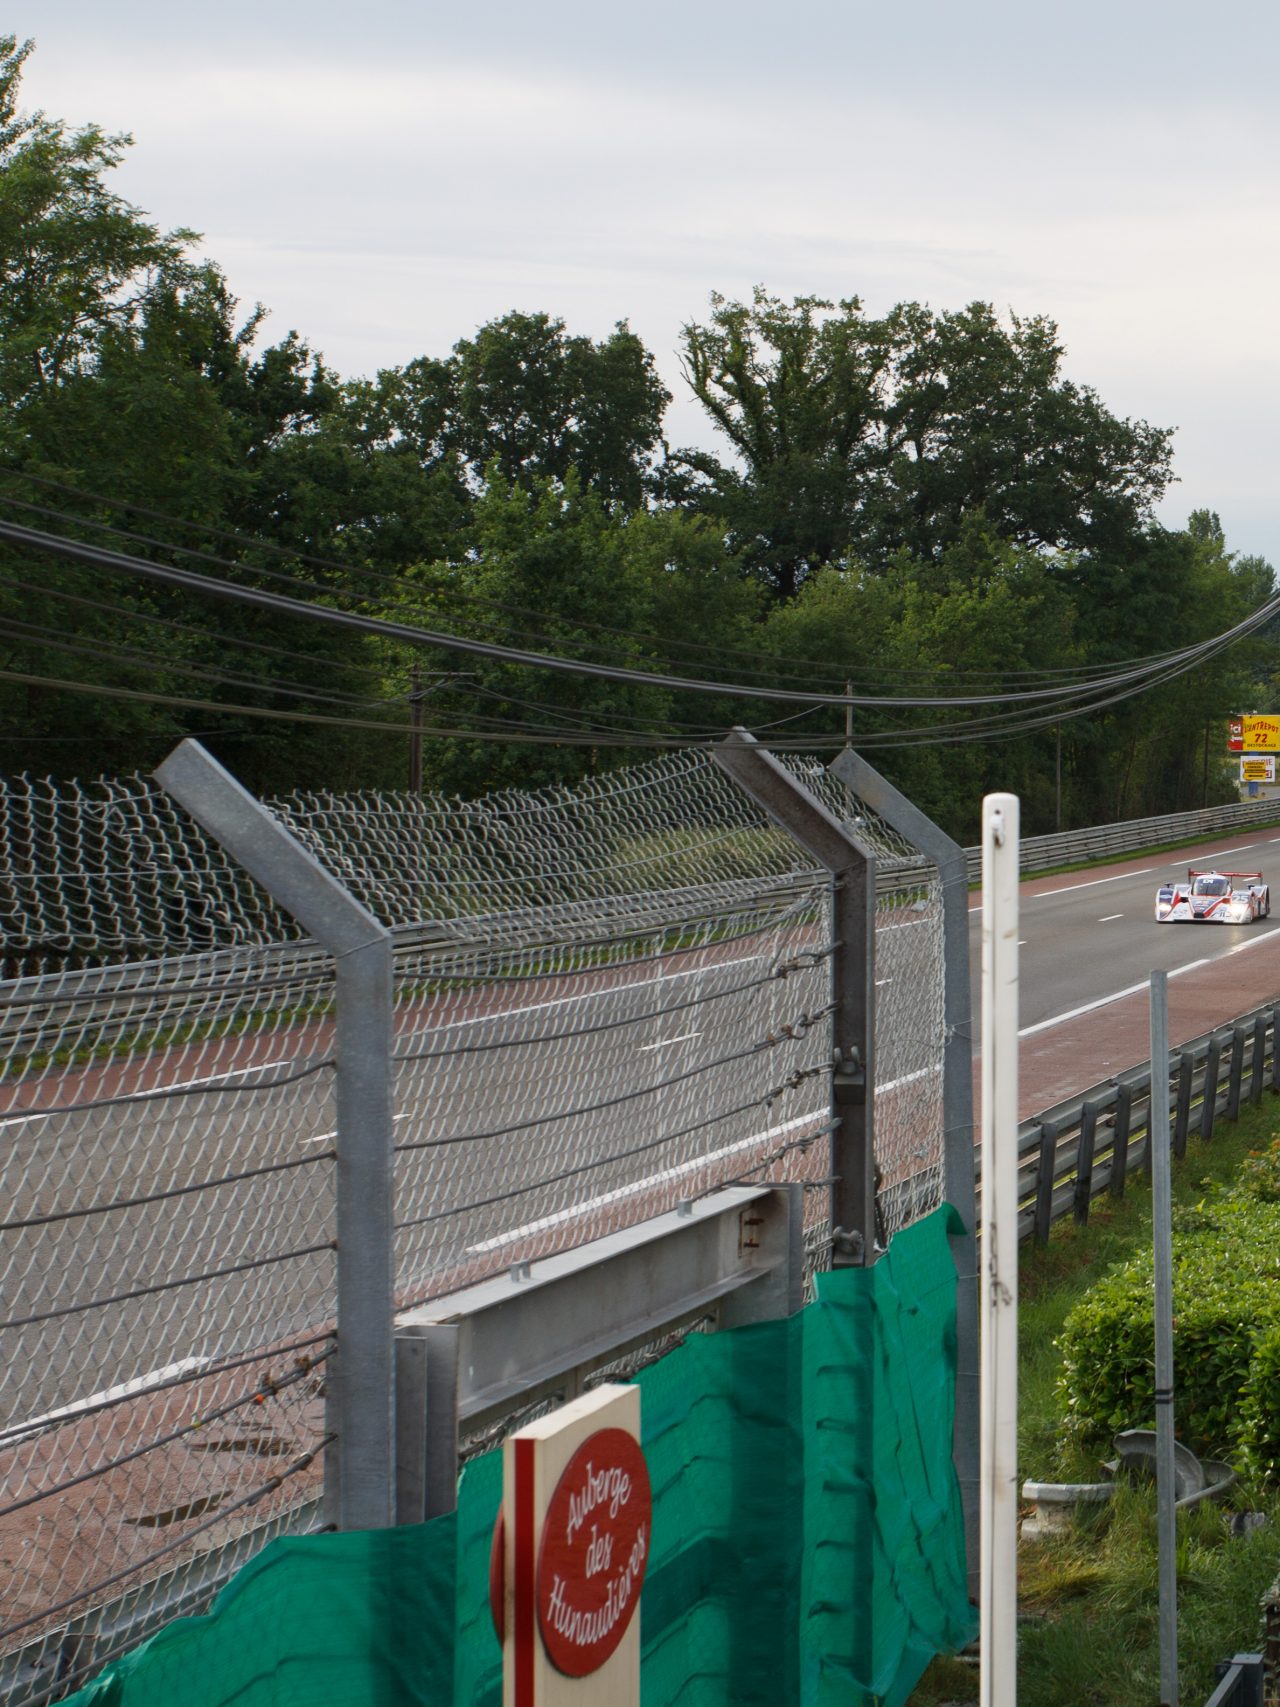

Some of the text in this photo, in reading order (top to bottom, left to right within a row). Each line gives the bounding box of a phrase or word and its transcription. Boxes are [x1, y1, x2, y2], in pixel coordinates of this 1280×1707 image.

[1255, 733, 1268, 743] 72
[1232, 895, 1249, 904] 25
[566, 1461, 632, 1546] Auberge
[585, 1525, 614, 1579] des
